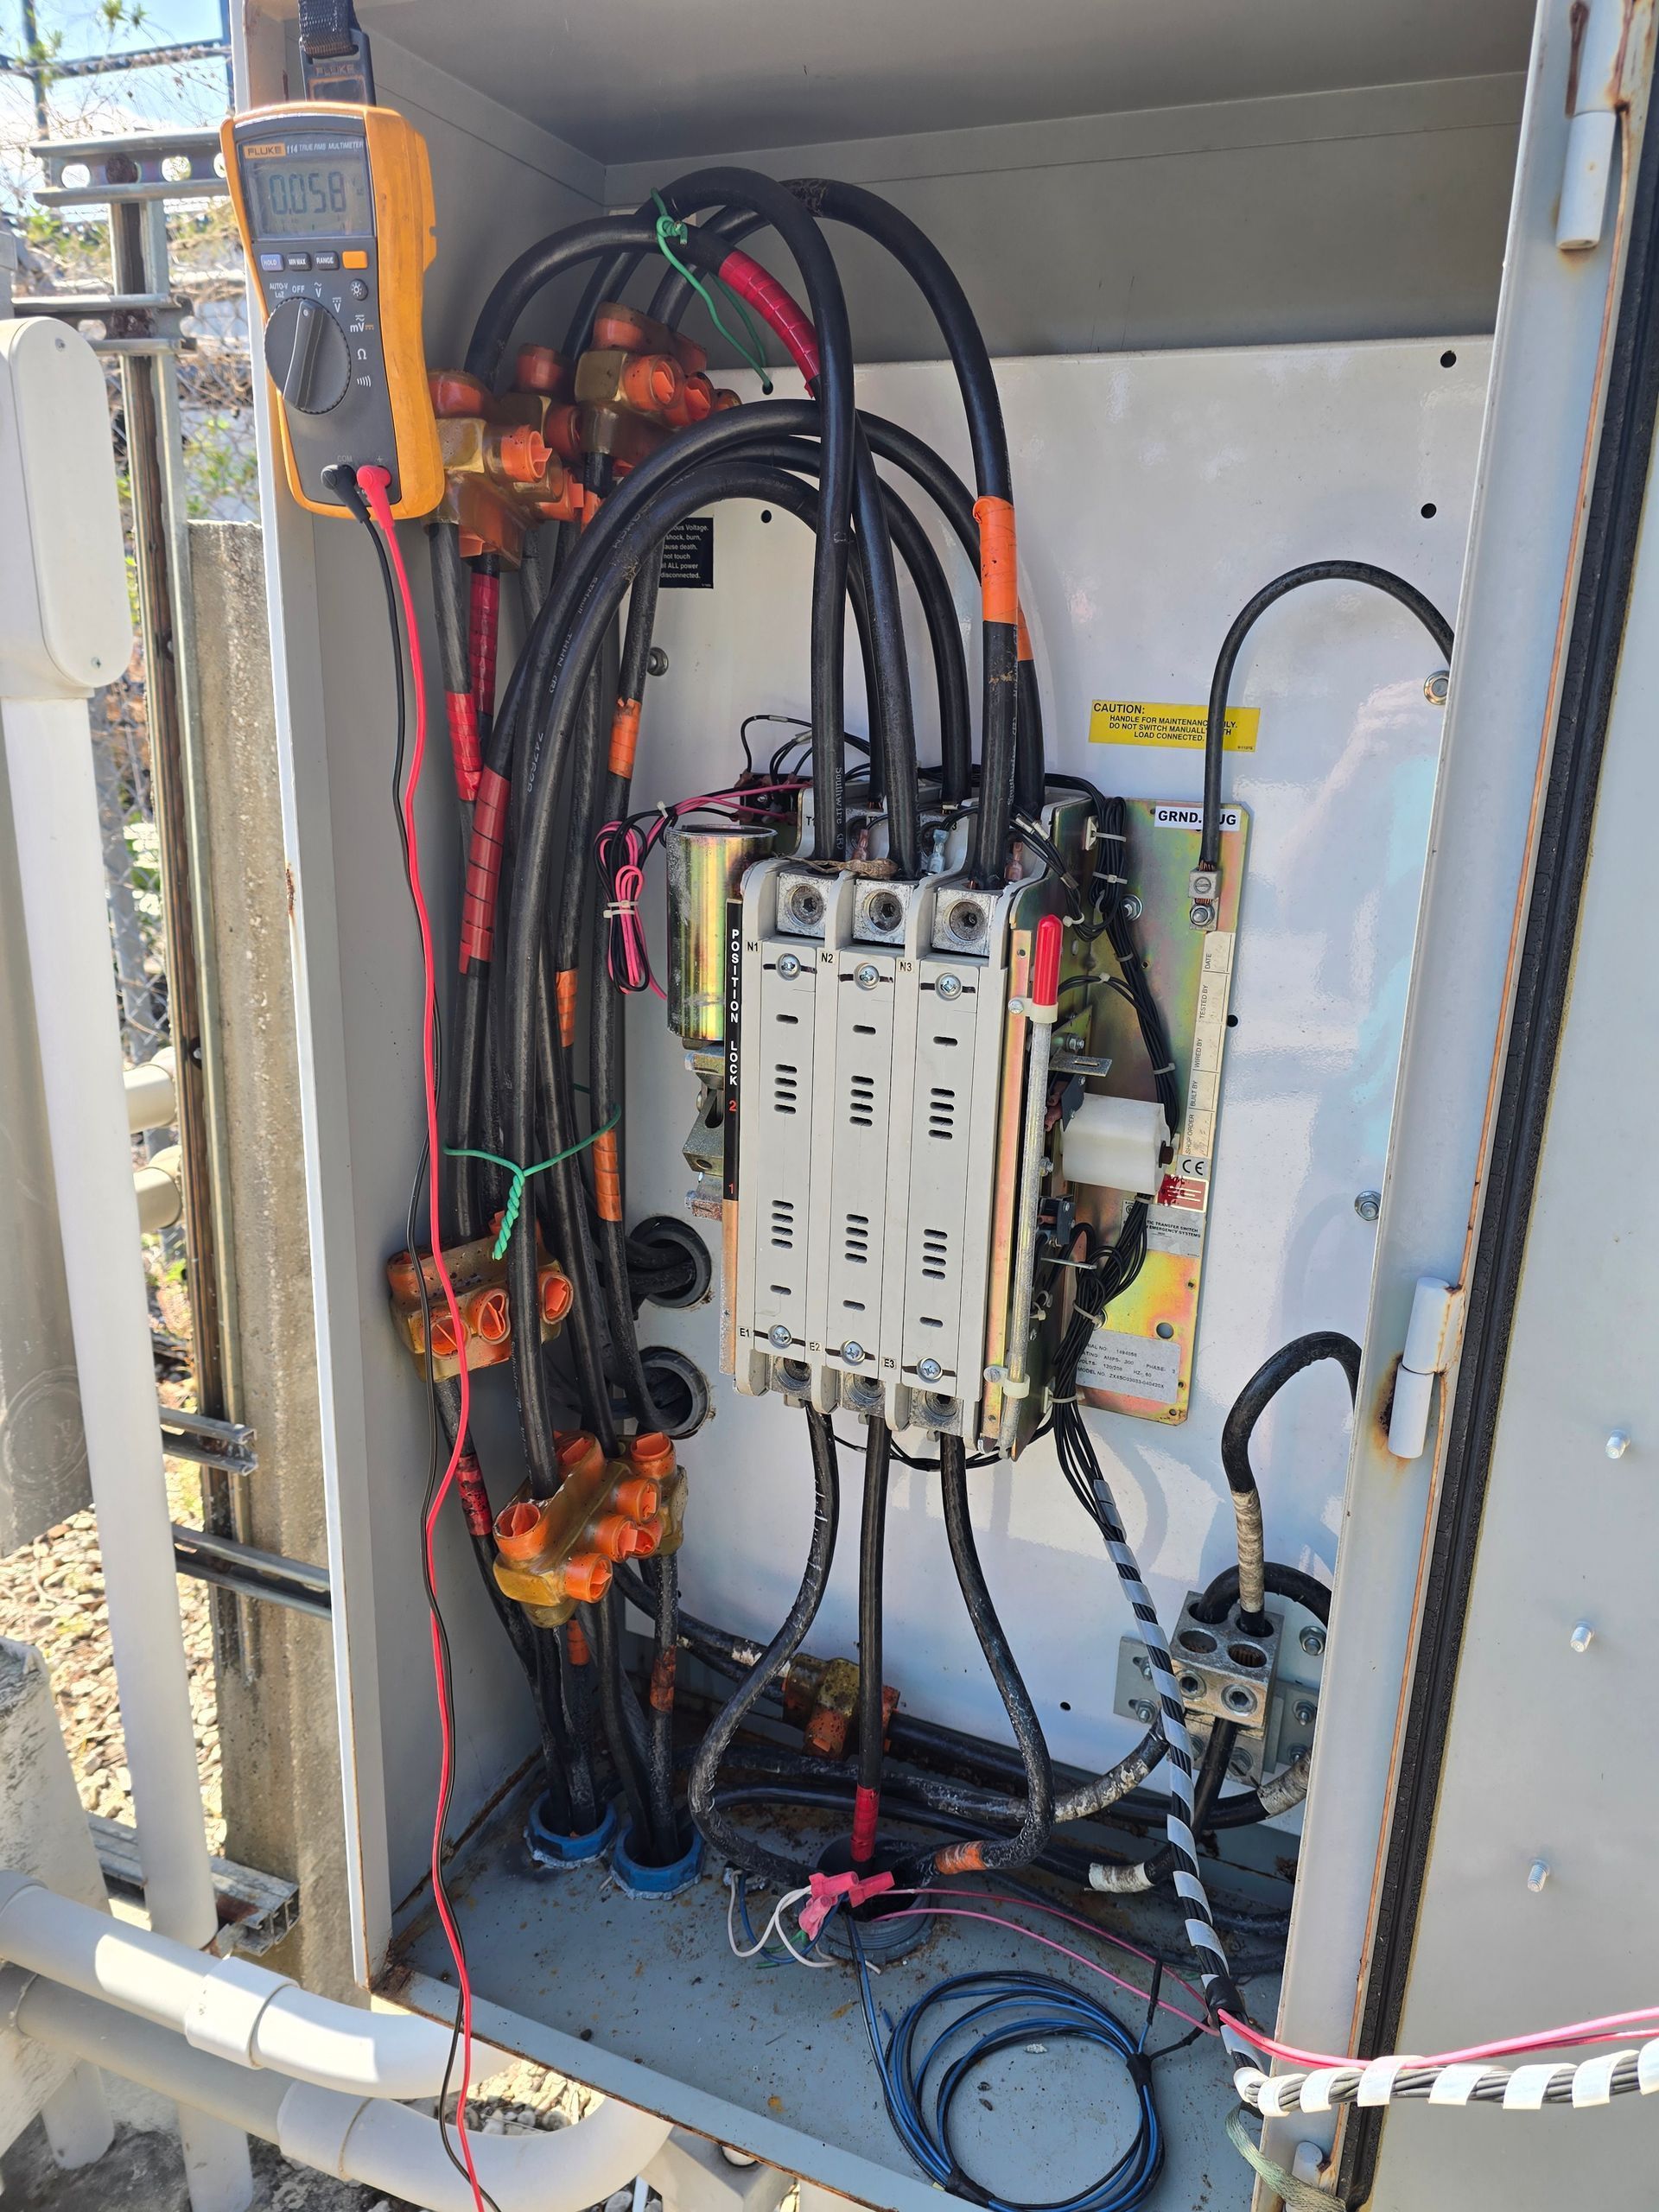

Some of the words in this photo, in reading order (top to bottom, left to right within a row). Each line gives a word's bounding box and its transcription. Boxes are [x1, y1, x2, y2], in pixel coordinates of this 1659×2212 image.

[315, 63, 355, 76] FLUKE
[247, 146, 283, 156] FLUKE
[287, 144, 298, 155] 114
[299, 143, 314, 152] TRUE
[328, 141, 364, 150] MULTIMETER
[292, 285, 305, 294] OFF
[350, 323, 365, 333] mV
[1094, 703, 1145, 714] CAUTION:
[1159, 718, 1208, 727] MAINTENANC
[1156, 733, 1205, 741] CONNECTED.
[1158, 810, 1203, 823] GRND.
[746, 941, 760, 952] N1
[821, 953, 834, 963] N2
[899, 961, 913, 972] N3
[730, 928, 741, 1024] POSITION
[1202, 985, 1208, 997] BY
[1197, 1038, 1203, 1046] BY
[729, 1040, 738, 1086] LOCK
[1193, 1080, 1198, 1089] BY
[728, 1100, 737, 1112] 2
[1183, 1160, 1205, 1176] CE
[728, 1183, 735, 1194] 1
[1149, 1225, 1179, 1234] EMERGENCY
[1155, 1221, 1179, 1230] TRANSFER
[739, 1328, 750, 1338] E1
[809, 1342, 821, 1353] E2
[884, 1358, 896, 1370] E3
